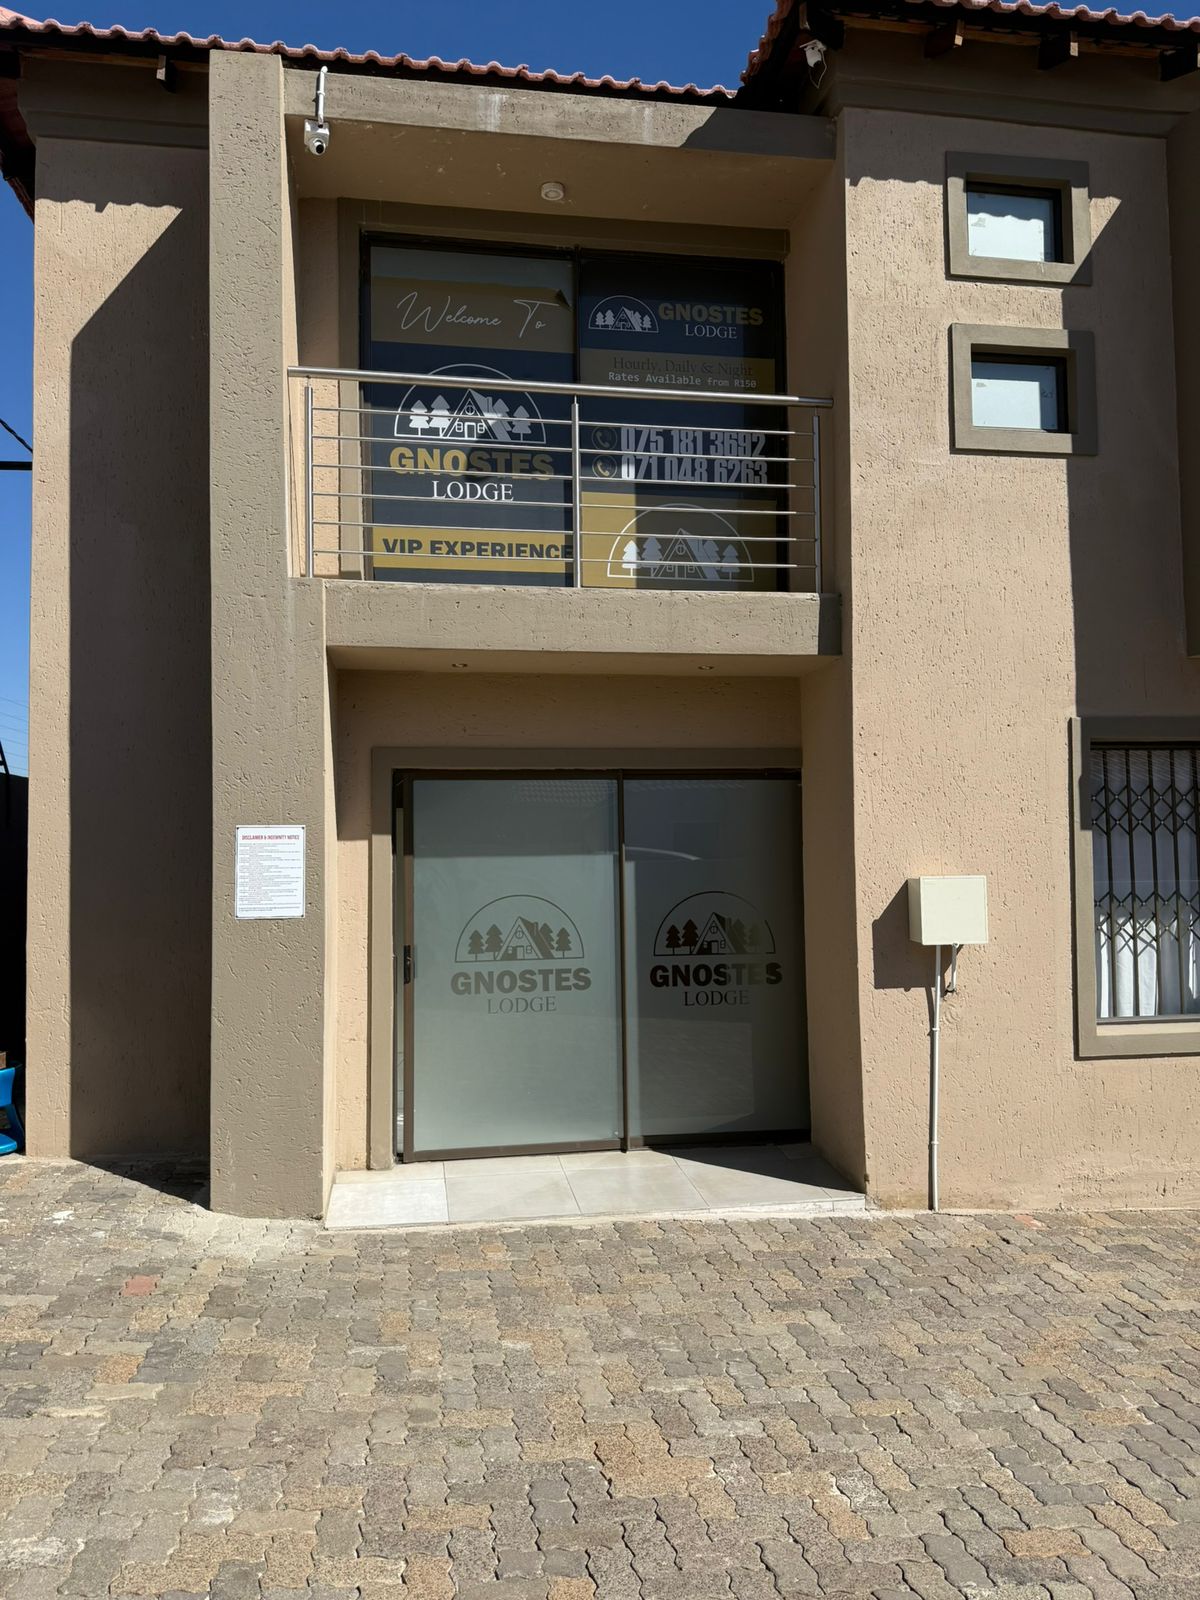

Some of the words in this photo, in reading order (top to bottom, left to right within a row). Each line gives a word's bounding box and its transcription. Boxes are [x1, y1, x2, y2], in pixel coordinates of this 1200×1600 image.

[397, 291, 502, 332] Welcome
[513, 299, 560, 338] To
[658, 302, 764, 326] GNOSTES
[685, 324, 738, 339] LODGE
[608, 371, 640, 382] Rates
[645, 374, 702, 385] Available
[707, 377, 730, 387] from
[734, 379, 758, 388] R150
[665, 359, 697, 375] Daily
[702, 362, 713, 374] &
[719, 363, 753, 378] Night
[620, 427, 664, 452] 075
[671, 429, 703, 455] 181
[709, 432, 766, 457] 3692
[389, 447, 554, 480] GNOSTES
[621, 455, 658, 480] 071
[664, 457, 708, 482] 048
[713, 460, 768, 485] 6263
[432, 481, 514, 501] LODGE
[382, 538, 423, 554] VIP
[430, 540, 574, 559] EXPERIENCE
[451, 967, 592, 995] GNOSTES
[650, 962, 783, 987] GNOSTES
[487, 996, 557, 1014] LODGE
[684, 989, 750, 1006] LODGE
